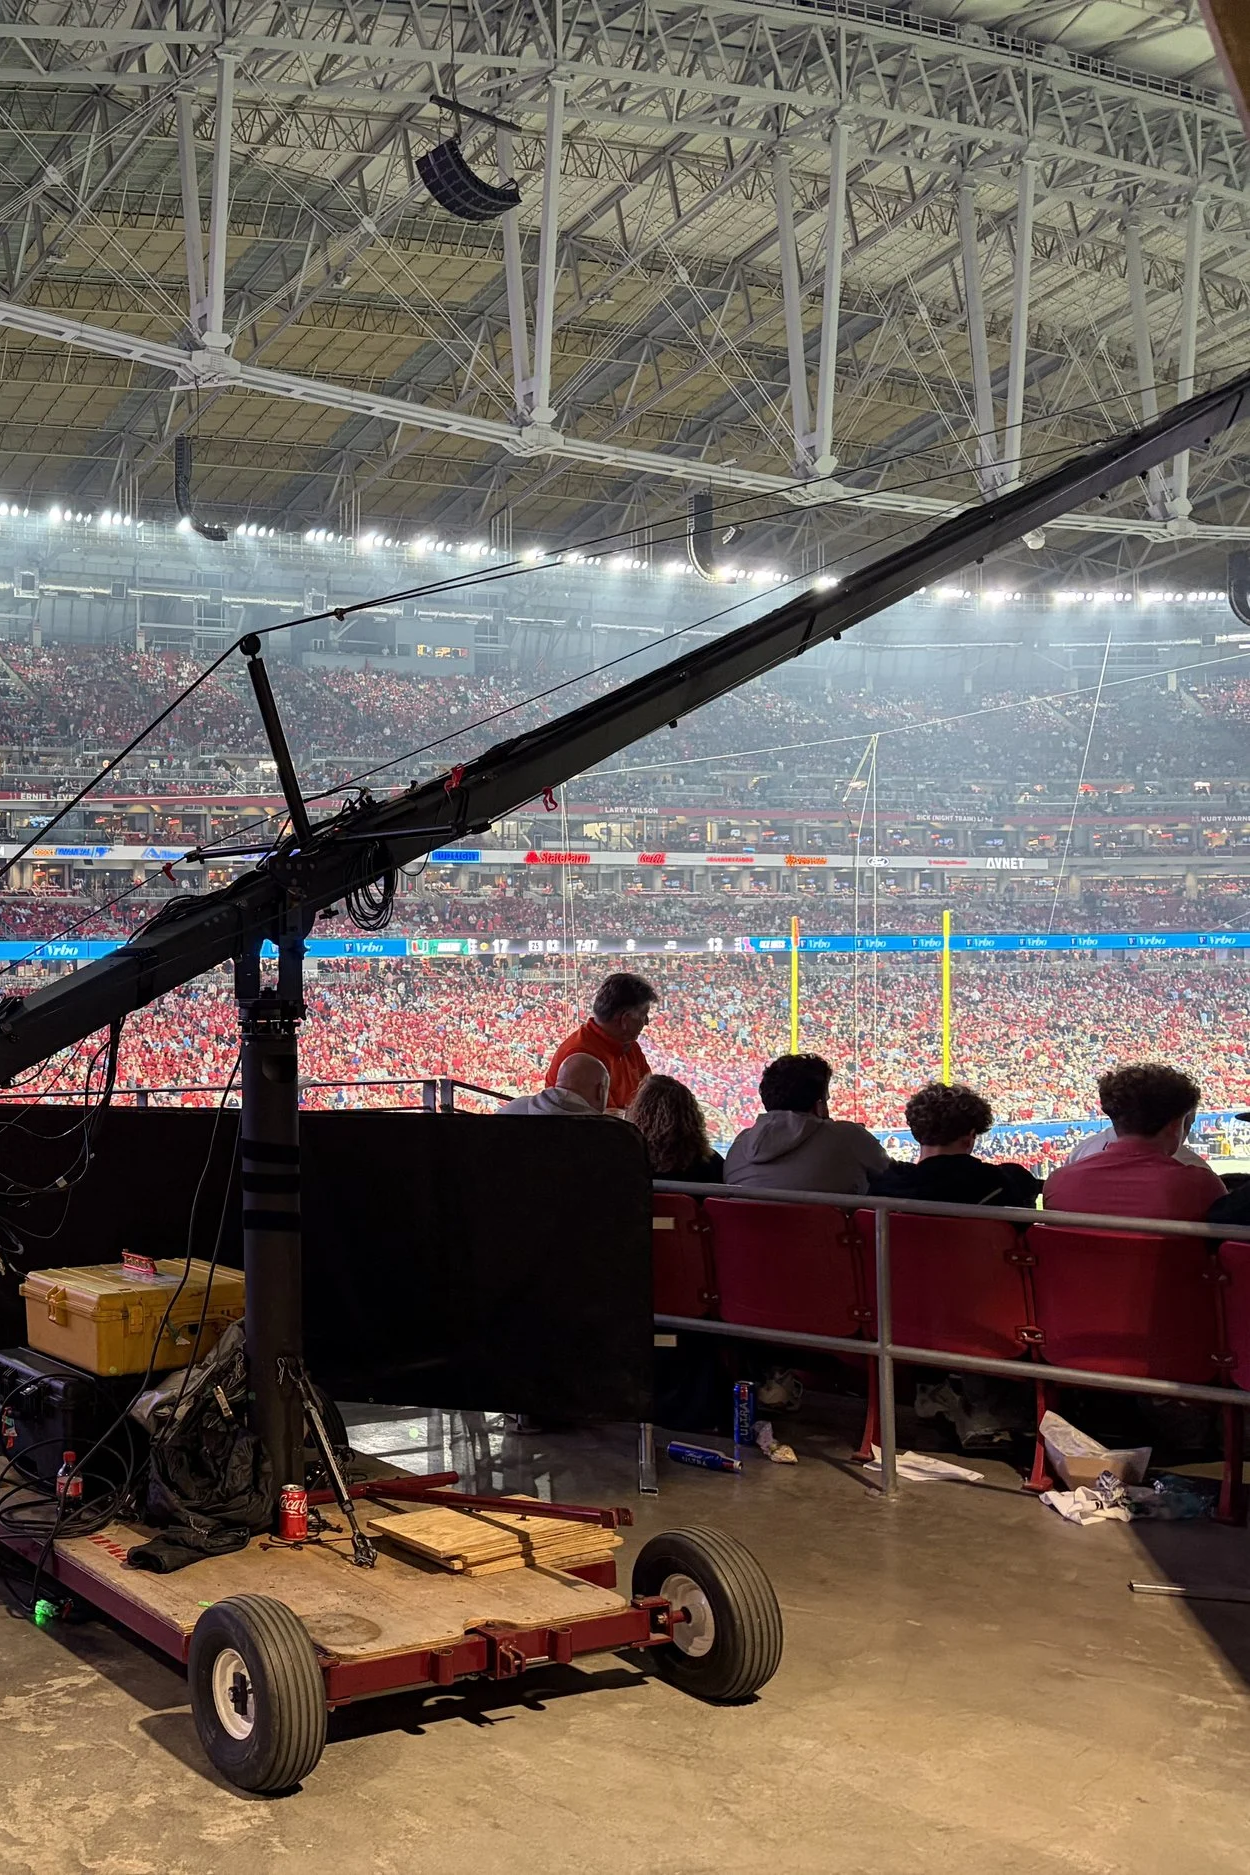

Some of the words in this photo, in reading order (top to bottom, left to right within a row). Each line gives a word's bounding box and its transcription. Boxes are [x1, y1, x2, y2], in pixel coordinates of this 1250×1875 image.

[20, 792, 47, 800] ERNIE
[604, 806, 629, 814] LARRY
[630, 807, 659, 815] WILSON
[986, 857, 1025, 869] AVNET
[46, 944, 79, 957] Vrbo
[355, 943, 384, 953] Vrbo
[492, 938, 510, 954] 17
